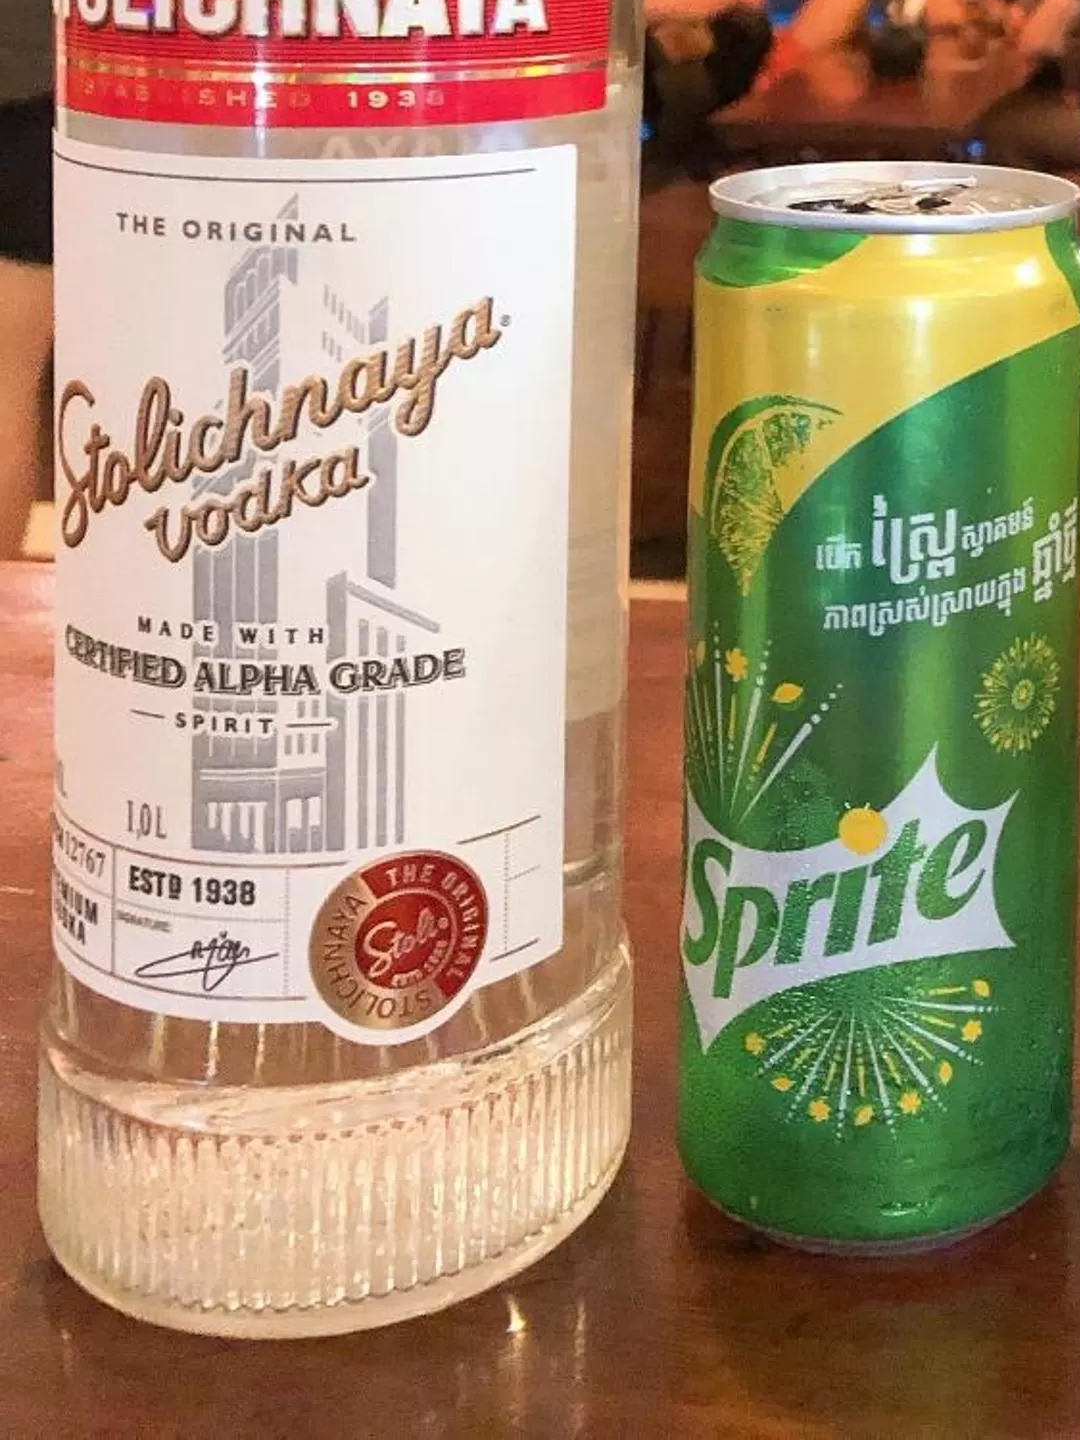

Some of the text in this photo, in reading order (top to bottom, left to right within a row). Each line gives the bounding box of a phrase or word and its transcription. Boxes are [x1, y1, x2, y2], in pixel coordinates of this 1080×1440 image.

[116, 211, 357, 244] THE ORIGINAL
[58, 296, 501, 549] Stolichnaya
[137, 616, 326, 646] MADE WITH
[64, 624, 466, 696] CERTIFIED ALPHA GRADE
[174, 712, 274, 734] SPIRIT
[192, 877, 256, 906] 1938
[385, 863, 436, 888] THE
[685, 818, 988, 1000] Sprite
[322, 895, 432, 1019] STOLICHNAYA
[363, 907, 448, 978] Stoli
